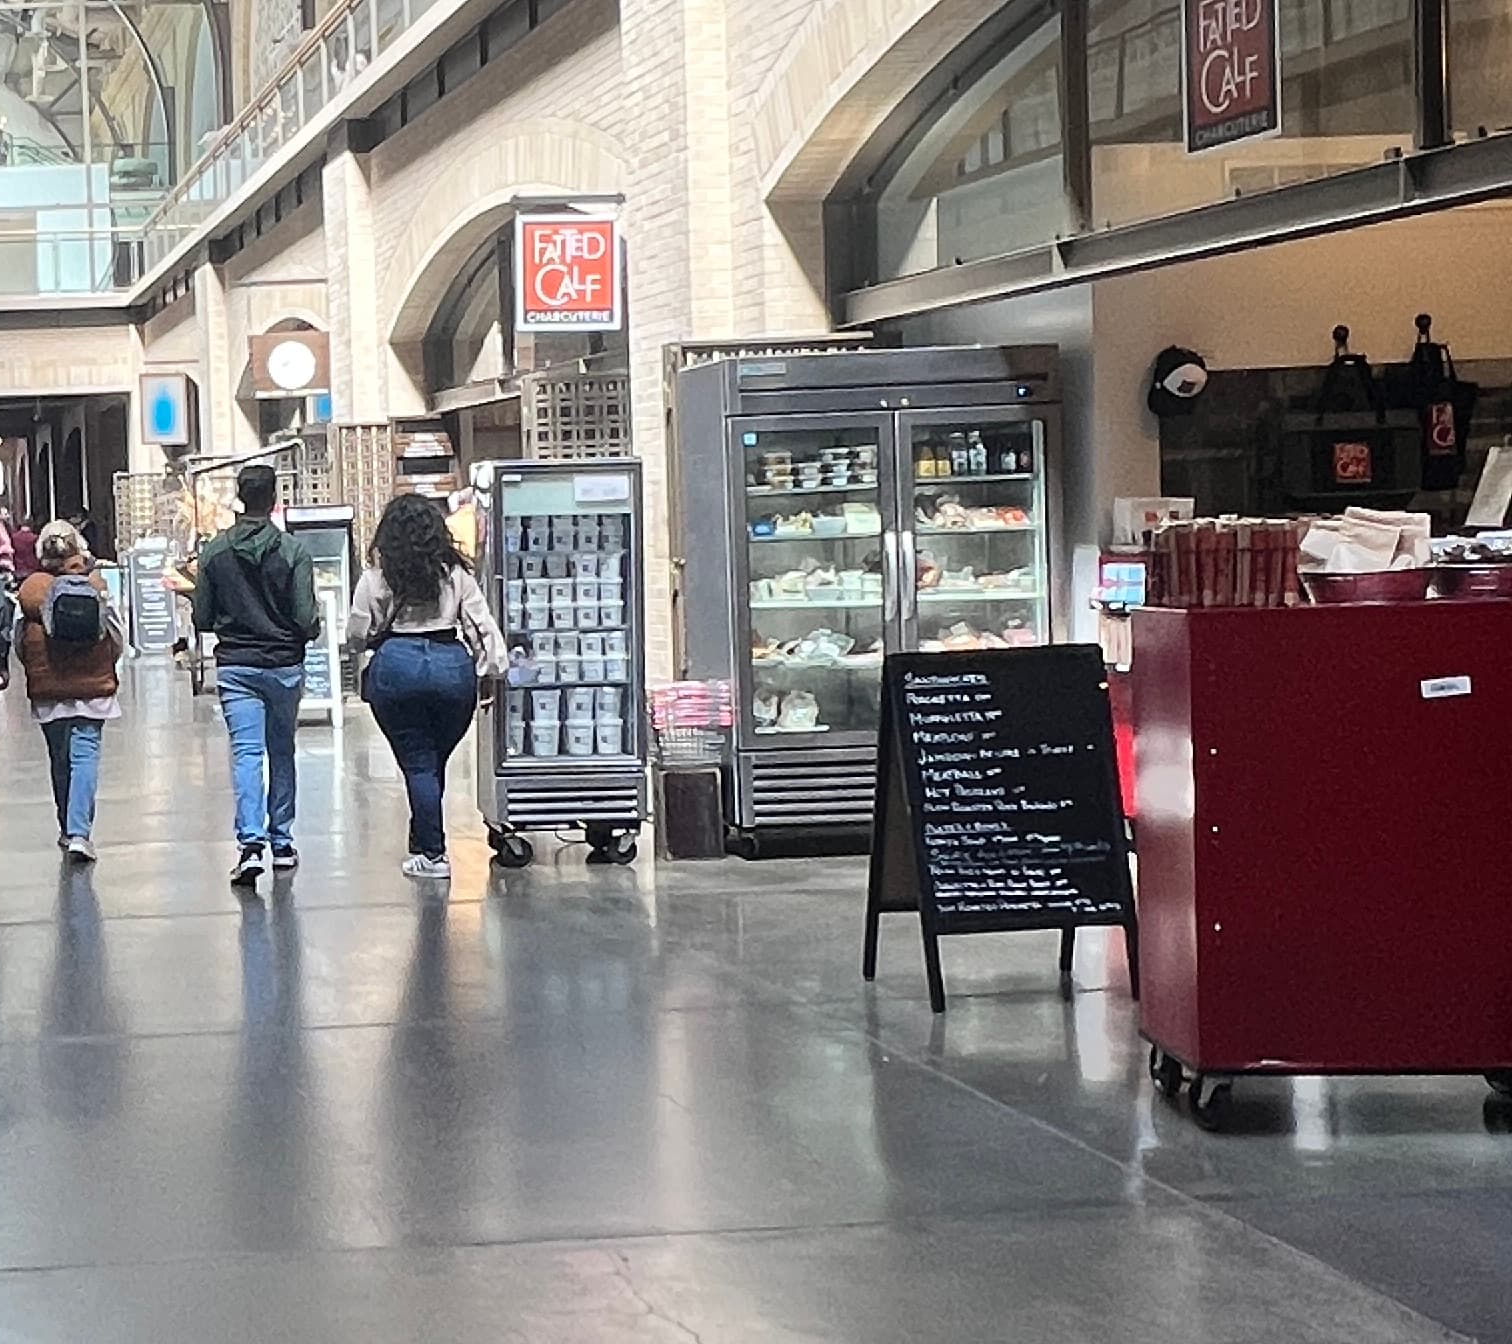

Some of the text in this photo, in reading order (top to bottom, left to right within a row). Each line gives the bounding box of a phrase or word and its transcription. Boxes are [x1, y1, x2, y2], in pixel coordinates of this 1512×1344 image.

[1201, 46, 1259, 114] CALF
[533, 228, 606, 265] FATTED
[534, 263, 602, 307] CALF
[527, 311, 610, 323] CHARCUTERIE
